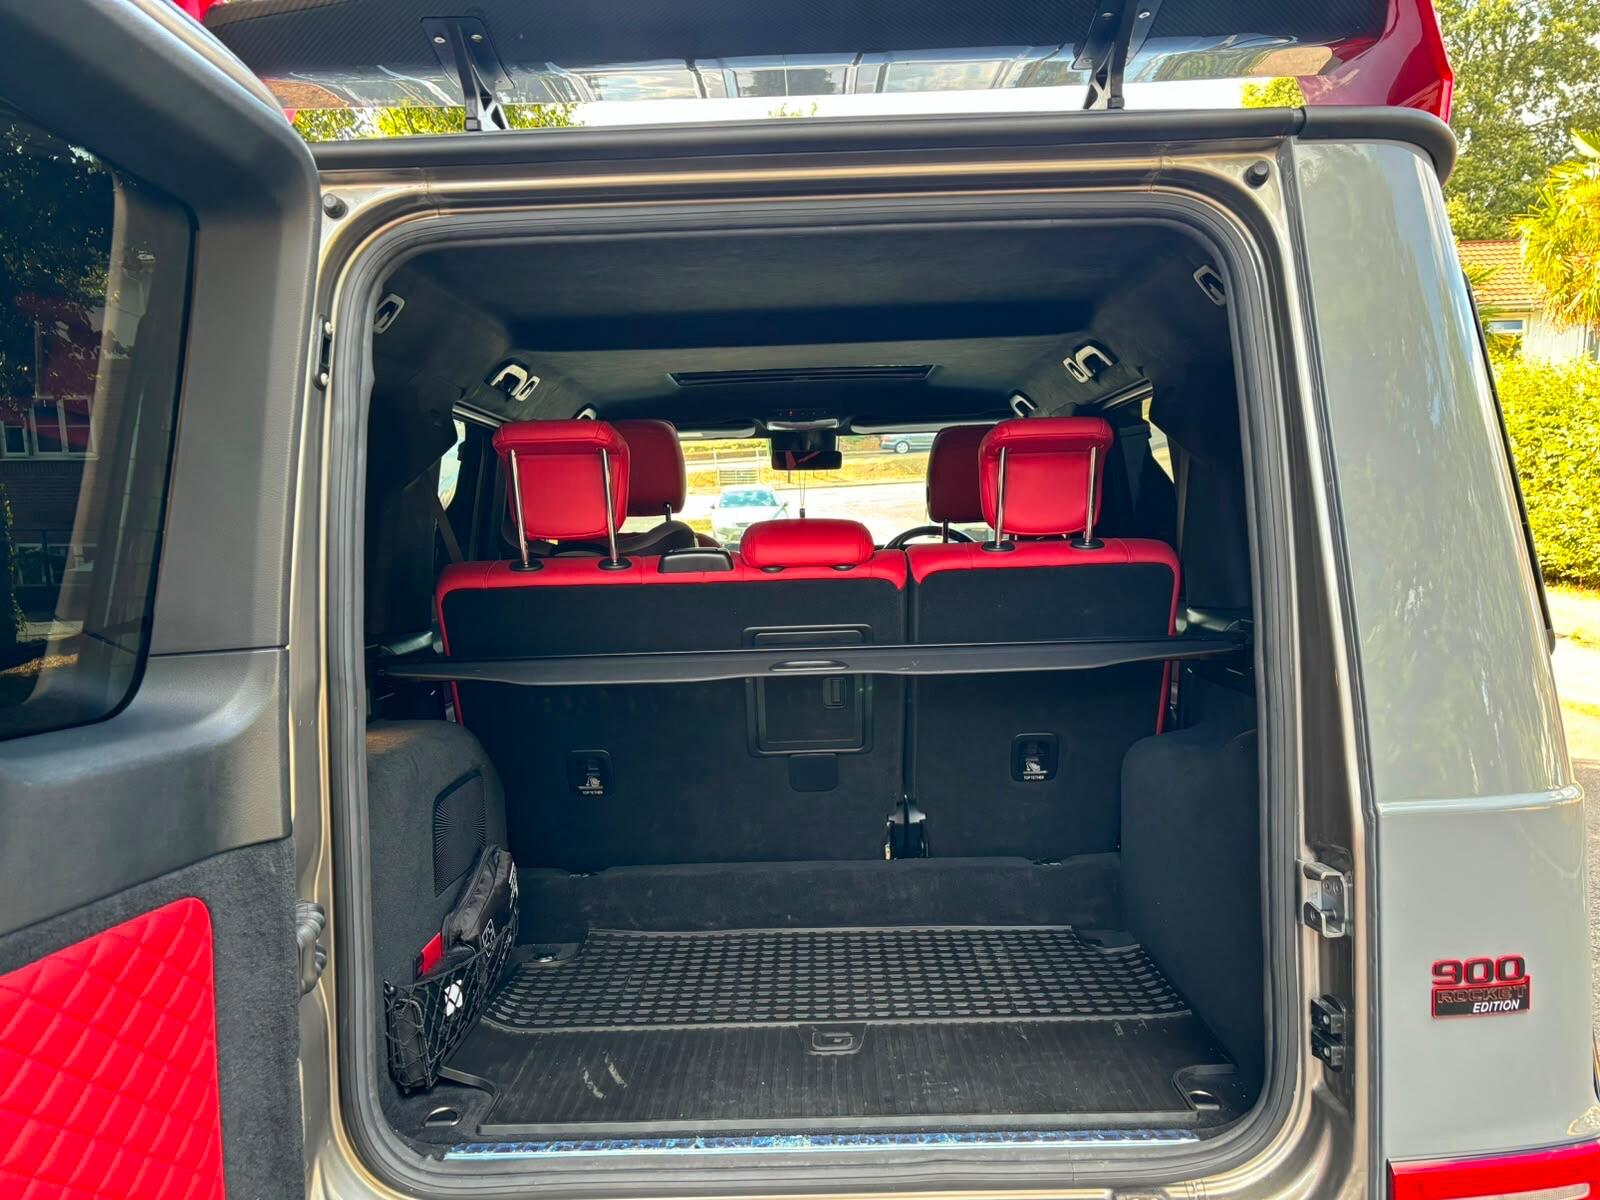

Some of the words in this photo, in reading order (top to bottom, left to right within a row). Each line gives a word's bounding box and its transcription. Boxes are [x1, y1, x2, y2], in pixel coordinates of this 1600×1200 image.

[1432, 955, 1526, 985] 900
[1437, 985, 1527, 1004] ROCKET
[1472, 1000, 1520, 1013] EDITION
